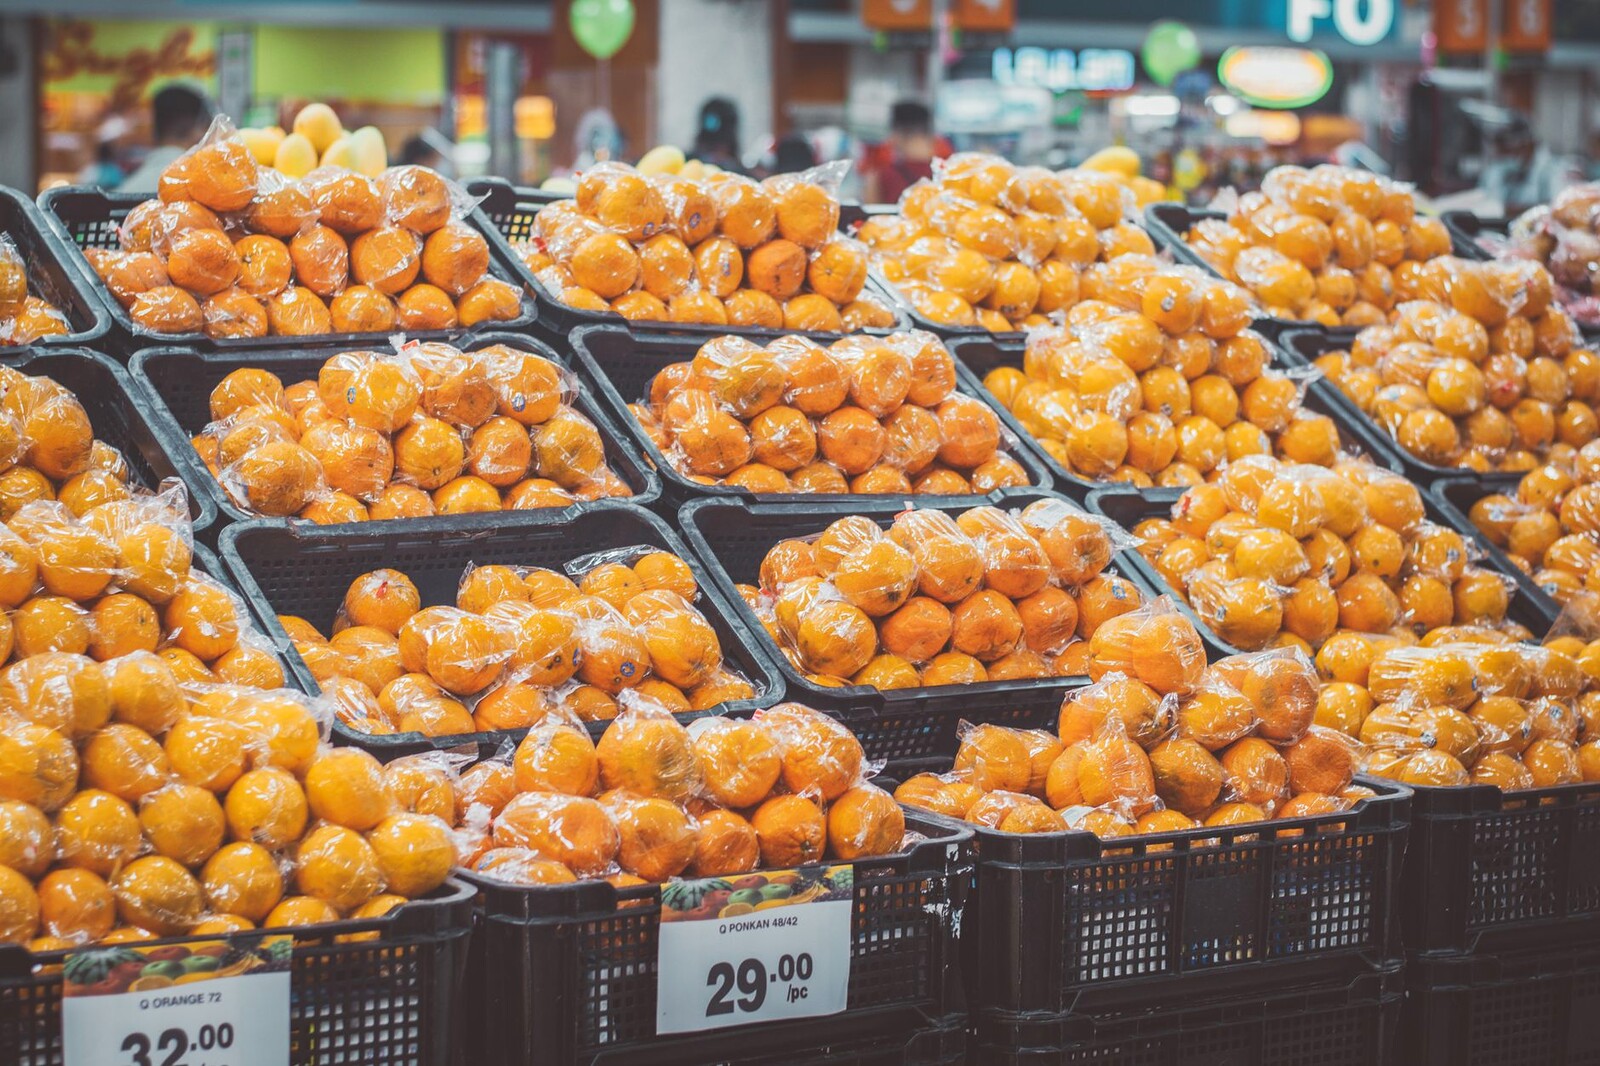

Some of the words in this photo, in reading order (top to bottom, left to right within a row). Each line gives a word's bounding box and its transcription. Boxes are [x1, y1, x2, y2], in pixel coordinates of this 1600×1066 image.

[719, 924, 727, 934] Q
[729, 919, 770, 933] PONKAN
[772, 916, 799, 928] 48/42
[140, 998, 150, 1010] Q
[152, 993, 205, 1009] ORANGE
[208, 991, 222, 1003] 72
[786, 983, 809, 1004] /pc
